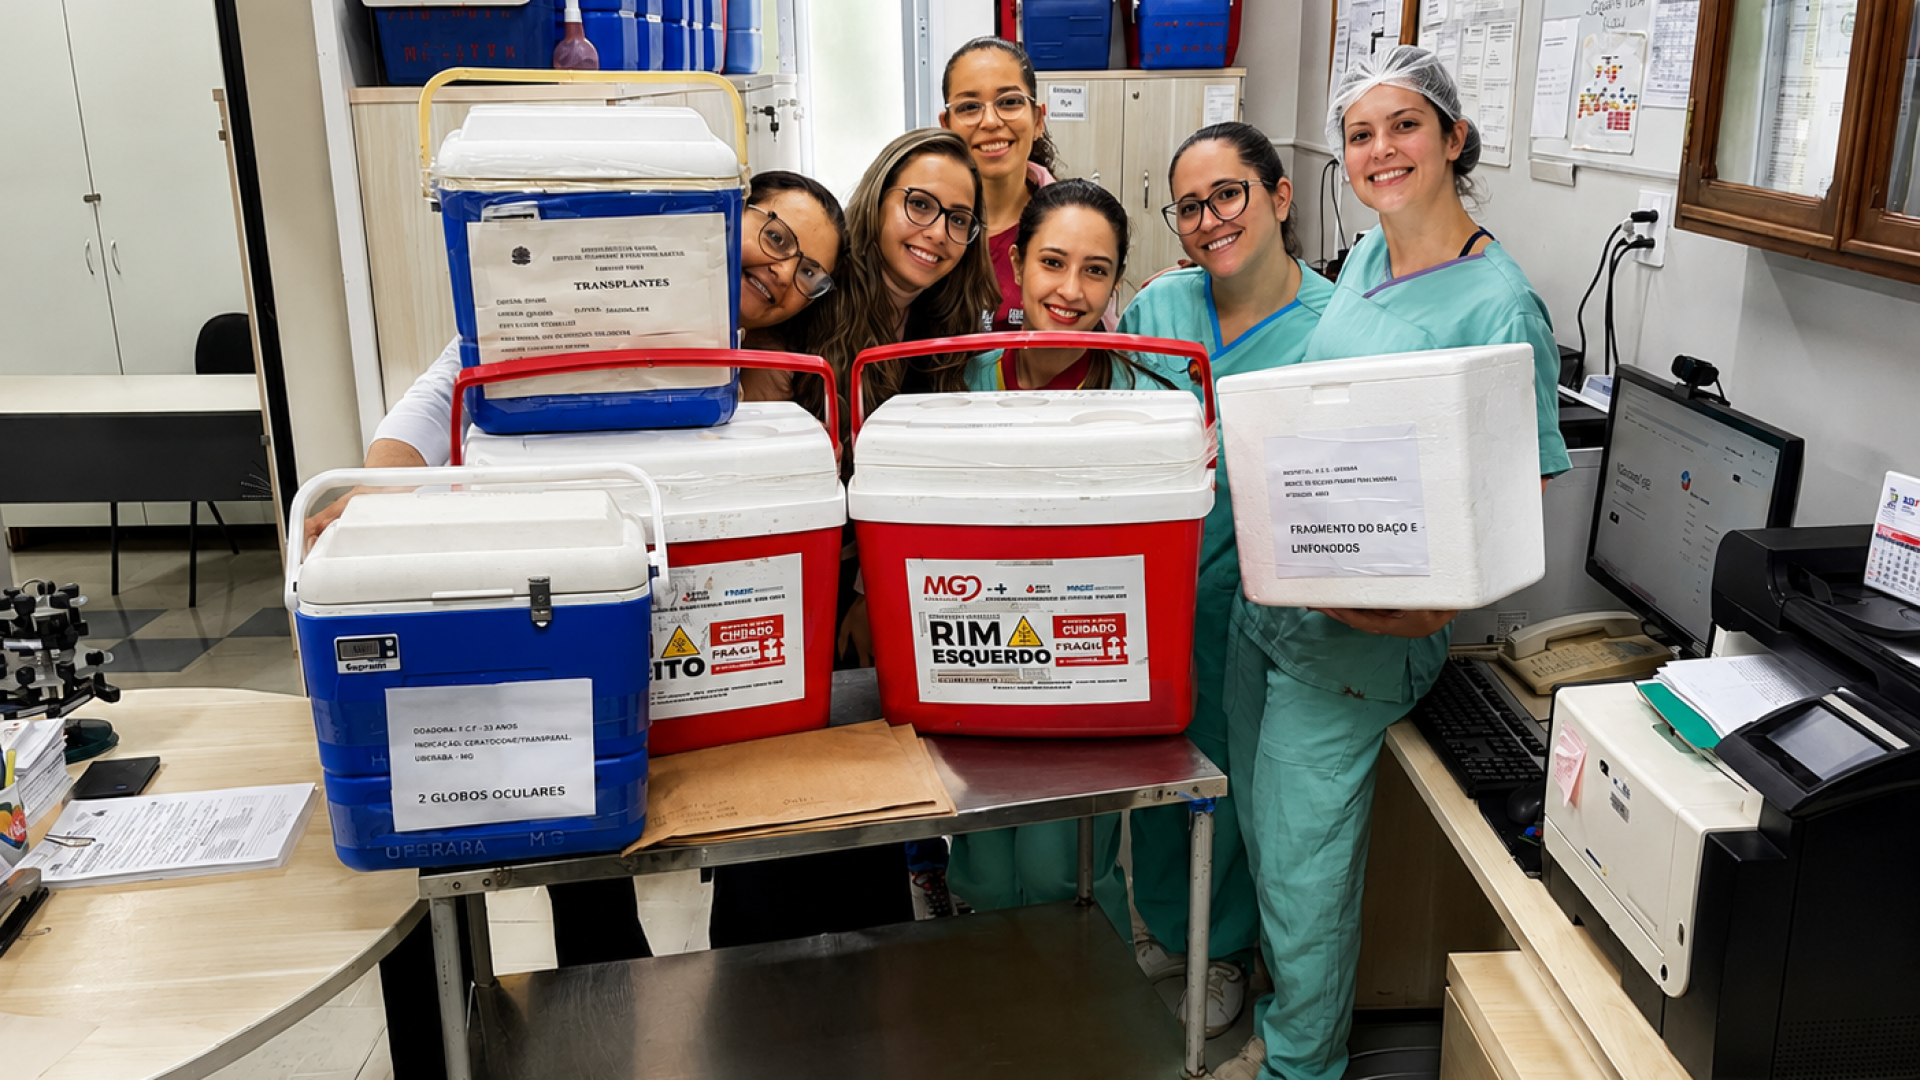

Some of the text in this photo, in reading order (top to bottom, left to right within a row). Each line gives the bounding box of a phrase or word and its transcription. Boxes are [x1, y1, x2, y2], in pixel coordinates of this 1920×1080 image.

[573, 278, 670, 291] TRANSPLANTES
[1358, 523, 1375, 534] DO
[1377, 522, 1408, 536] BAÇO
[1411, 522, 1418, 532] E
[1291, 542, 1361, 554] LINFONODOS
[929, 620, 1001, 647] RIM
[1062, 623, 1117, 636] CUIDADO
[933, 649, 1051, 667] ESQUERDO
[418, 786, 566, 804] 2 GLOBOS OCULARES
